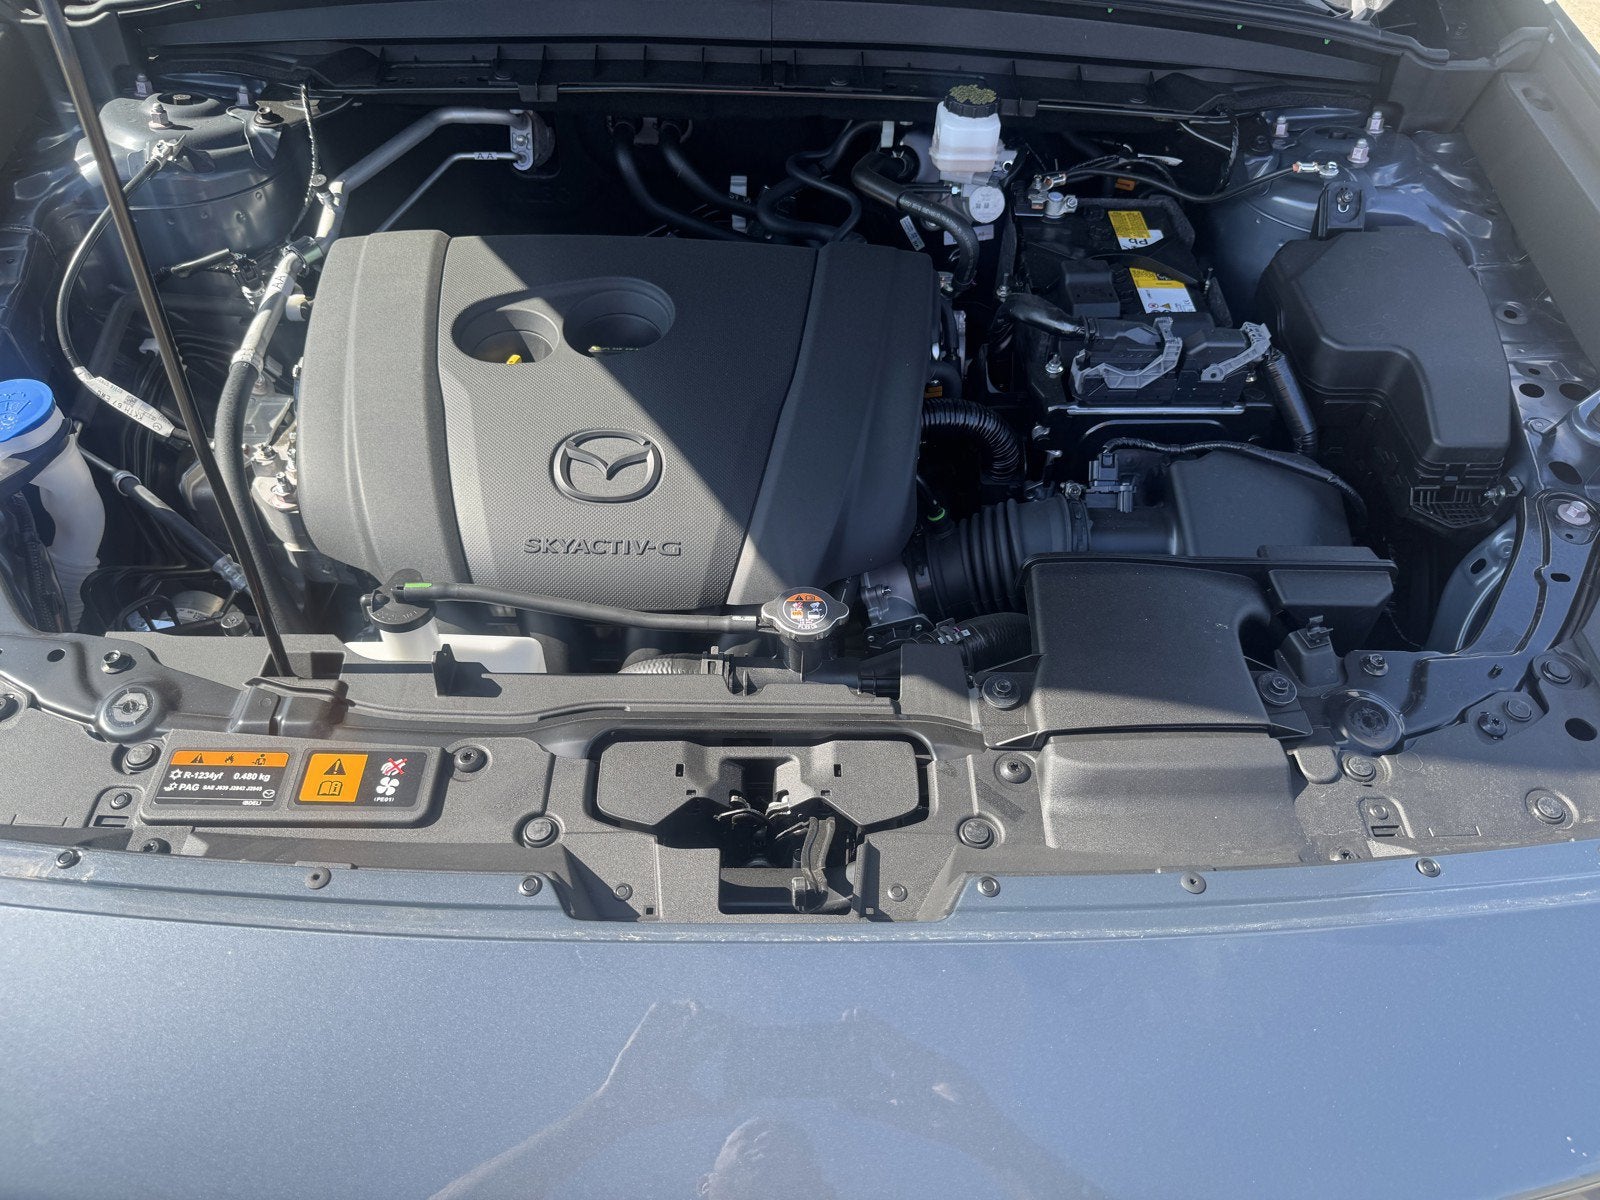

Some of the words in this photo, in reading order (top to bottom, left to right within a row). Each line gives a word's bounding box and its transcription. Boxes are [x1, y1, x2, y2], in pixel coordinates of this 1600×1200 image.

[523, 538, 682, 557] SKYACTIV-G
[183, 771, 224, 781] R-1234yf
[233, 772, 257, 780] 0.480
[258, 773, 271, 782] kg
[179, 783, 200, 791] PAG
